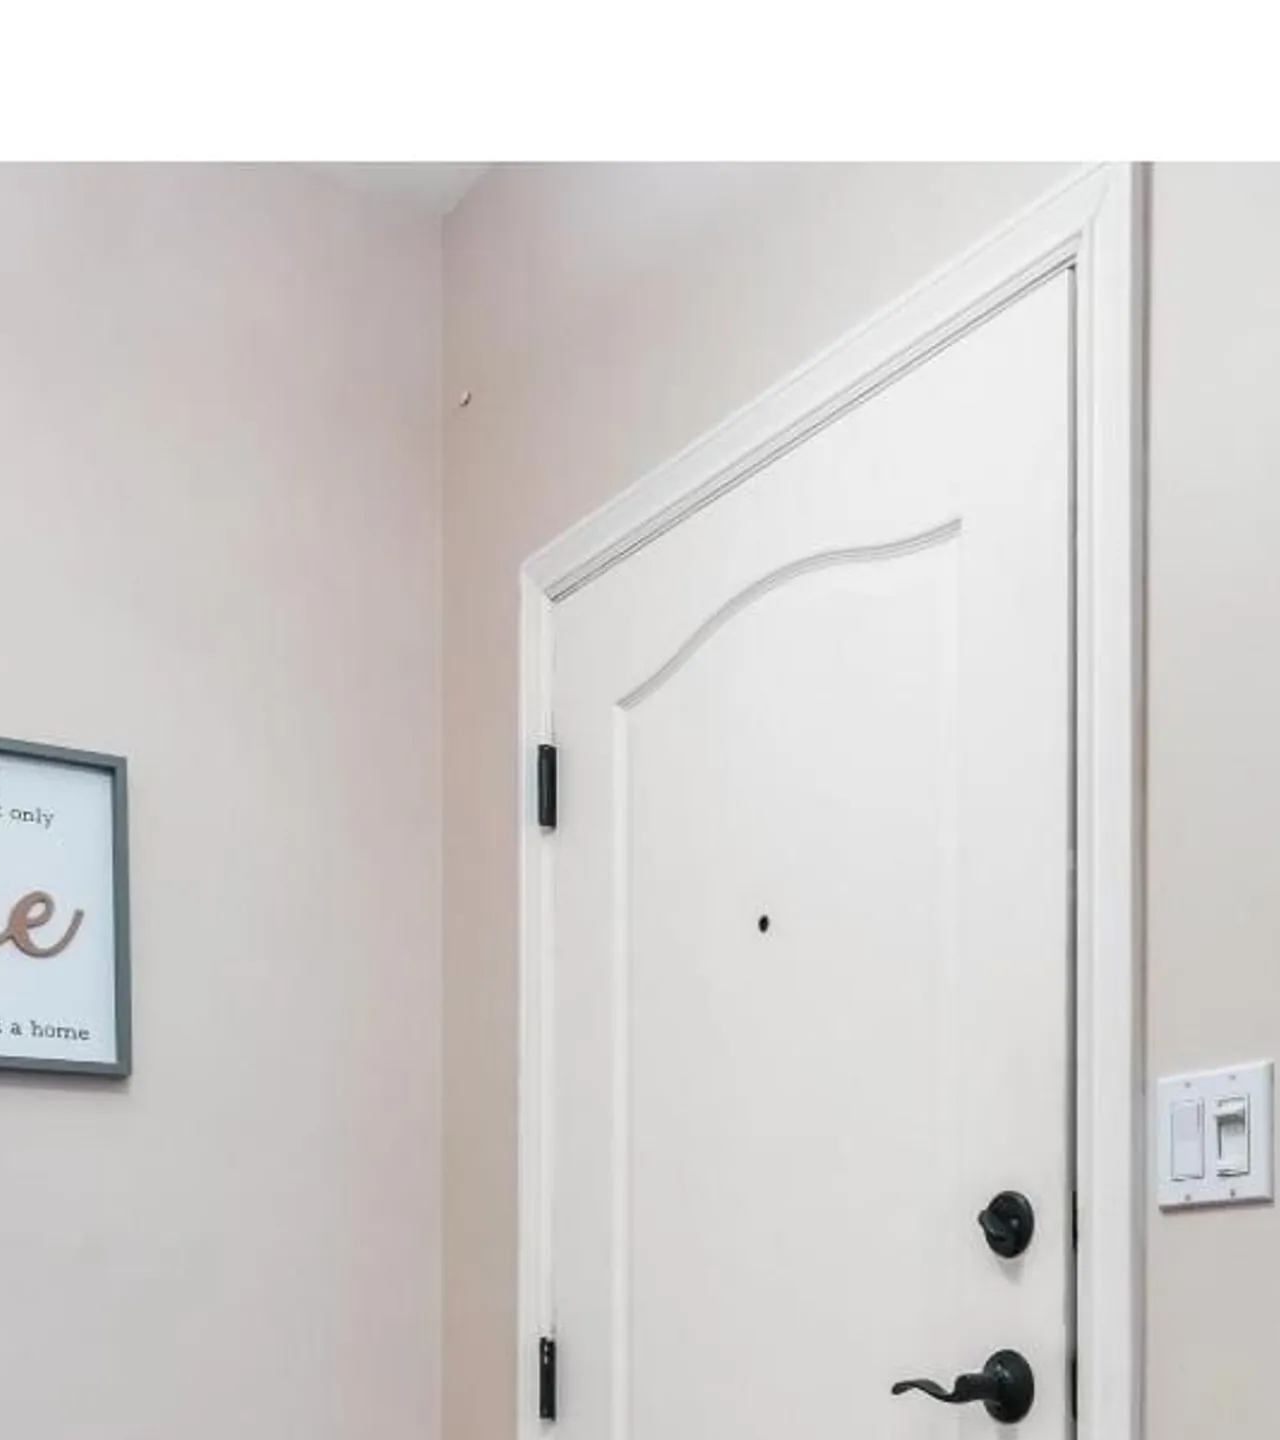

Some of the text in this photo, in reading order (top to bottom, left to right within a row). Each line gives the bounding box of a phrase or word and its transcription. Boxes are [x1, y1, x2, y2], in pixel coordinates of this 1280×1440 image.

[10, 805, 55, 828] only
[10, 1022, 22, 1036] a
[31, 1019, 90, 1041] home
